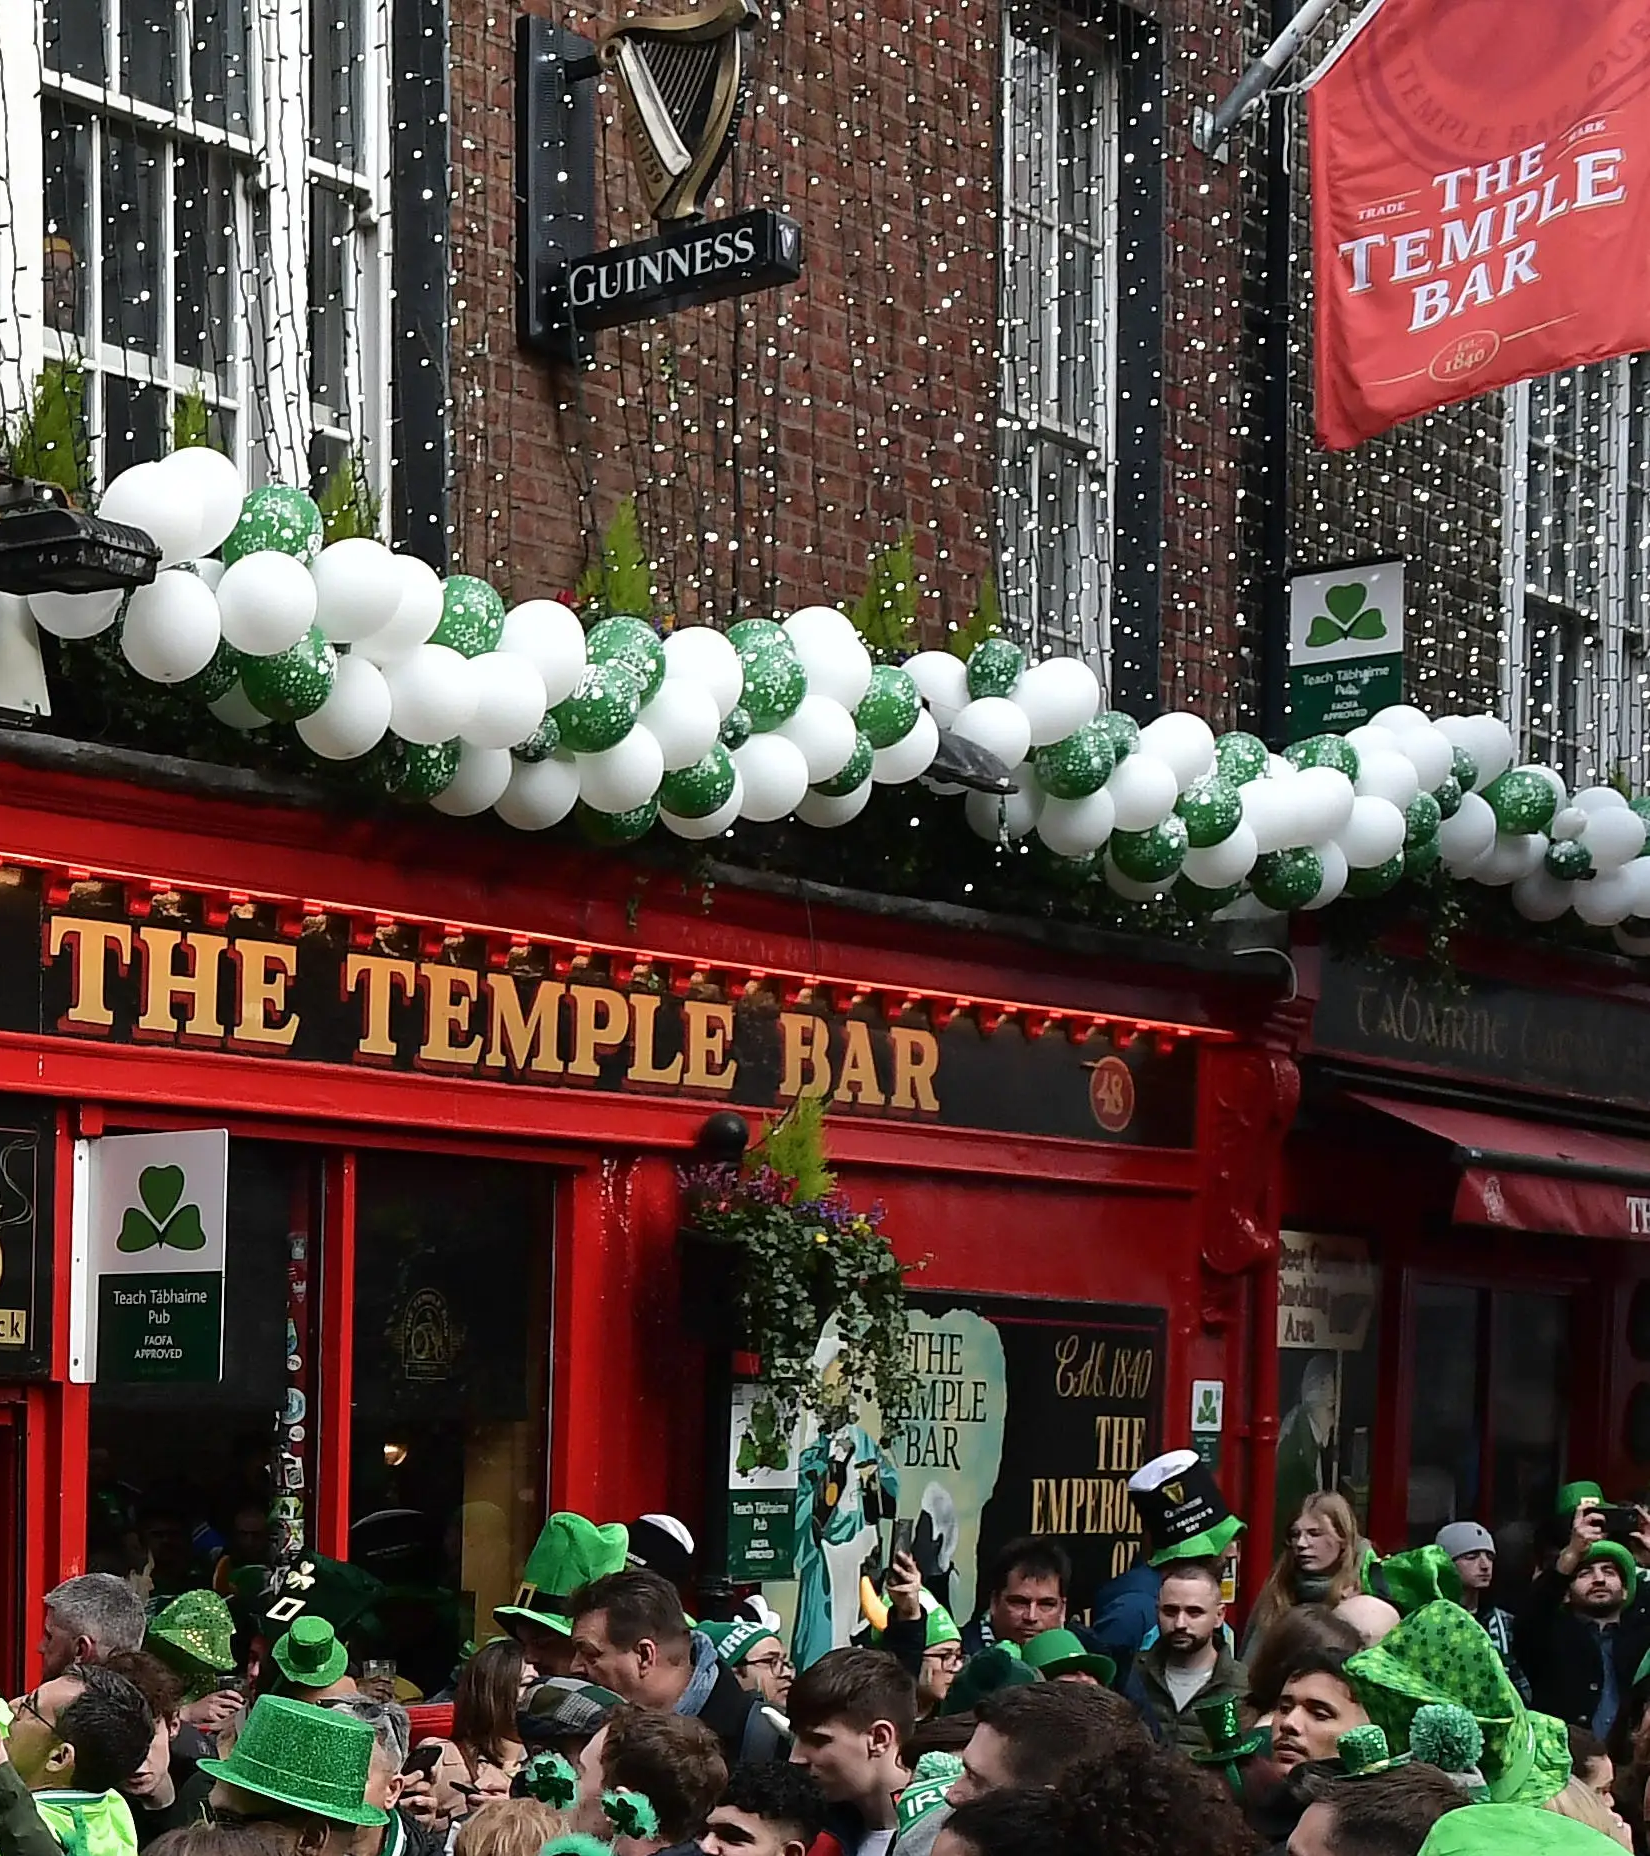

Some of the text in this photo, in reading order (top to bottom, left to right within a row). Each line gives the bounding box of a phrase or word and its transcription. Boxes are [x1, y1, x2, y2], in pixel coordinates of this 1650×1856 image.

[1432, 142, 1546, 213] THE
[1337, 148, 1627, 293] TEMPLE
[1356, 201, 1406, 222] TRADE
[569, 228, 756, 307] GUINNESS
[1407, 240, 1541, 333] BAR
[1442, 351, 1485, 374] 1840
[1302, 670, 1335, 687] Teach
[1334, 682, 1361, 698] Pub
[48, 914, 941, 1114] THE TEMPLE BAR
[1095, 1066, 1126, 1119] 48
[113, 1289, 147, 1305] Teach
[148, 1308, 171, 1325] Pub
[1284, 1310, 1316, 1343] Area
[133, 1348, 183, 1360] APPROVED
[908, 1331, 964, 1375] THE
[1109, 1347, 1153, 1399] 1840
[891, 1378, 988, 1422] EMPLE
[904, 1423, 961, 1471] BAR
[1095, 1415, 1147, 1472] THE
[752, 1517, 768, 1532] Pub
